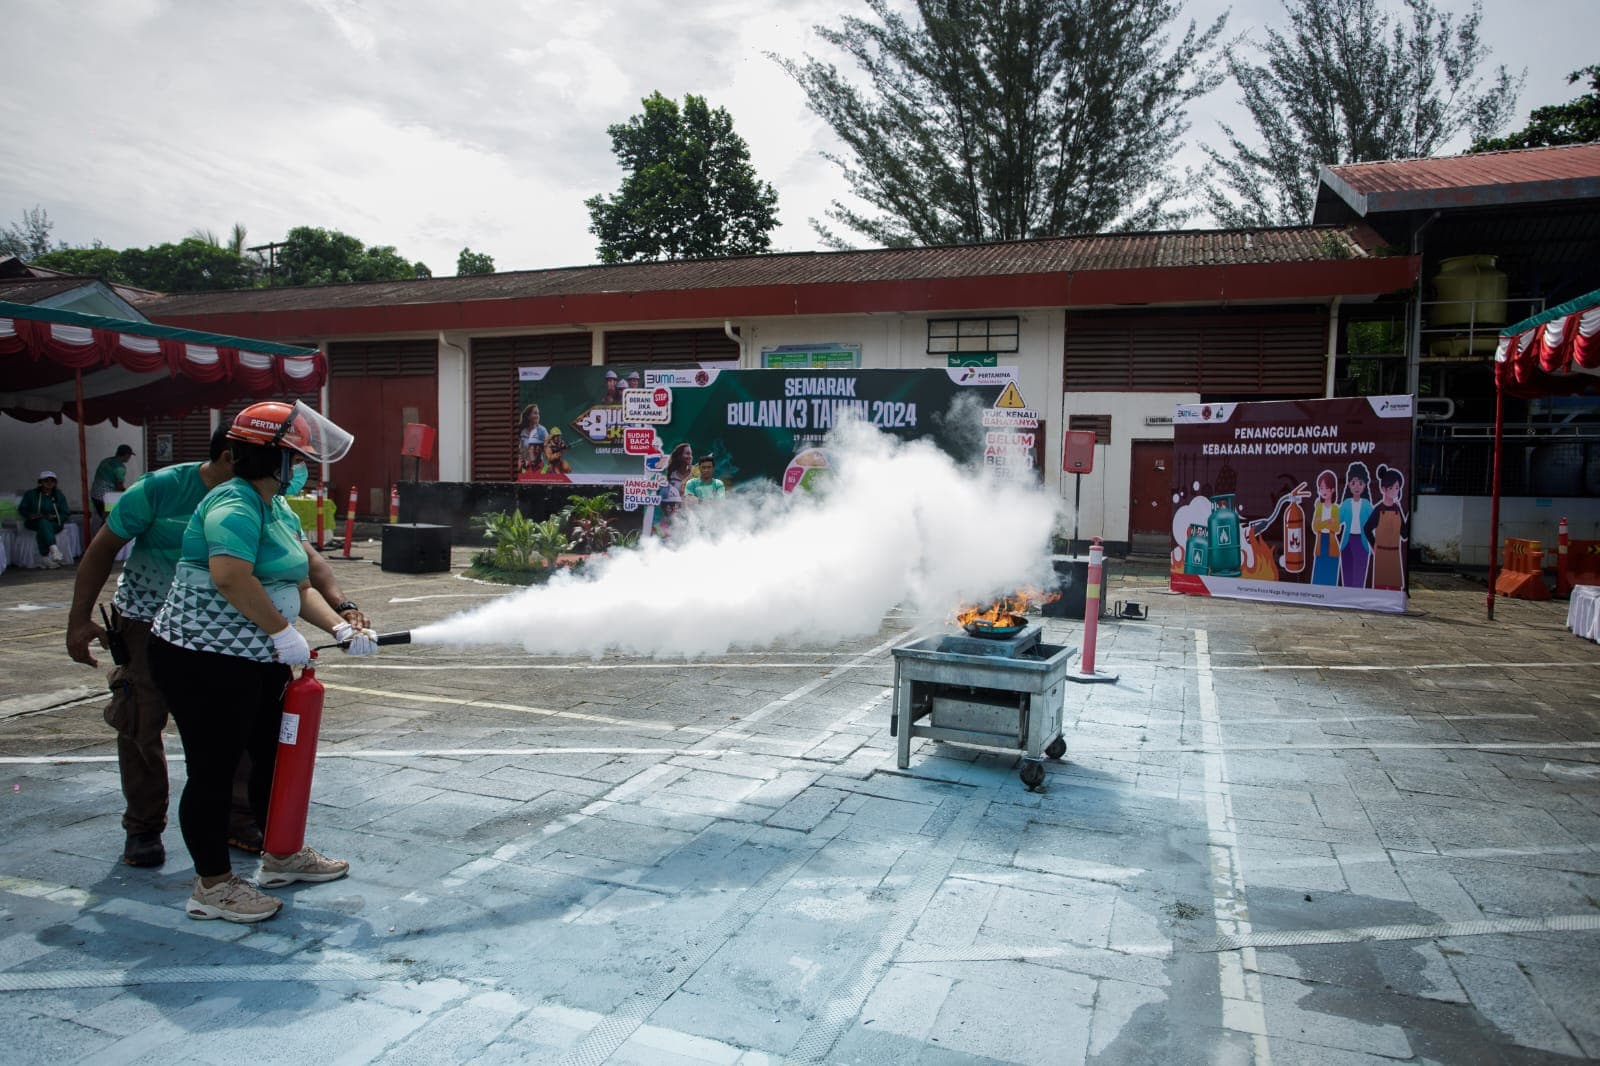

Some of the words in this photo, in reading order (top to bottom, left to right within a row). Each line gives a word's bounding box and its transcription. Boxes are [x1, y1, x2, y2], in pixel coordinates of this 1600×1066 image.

[784, 377, 857, 397] SEMARAK
[655, 393, 667, 401] STOP
[727, 400, 782, 428] BULAN
[785, 399, 808, 429] K3
[872, 400, 918, 429] 2024
[1006, 410, 1037, 419] KENALI
[250, 418, 296, 433] PERTAMA
[1235, 425, 1338, 439] PENANGGULANGAN
[987, 433, 1033, 446] BELUM
[1202, 443, 1262, 455] KEBAKARAN
[1265, 442, 1309, 455] KOMPOR
[1311, 442, 1348, 455] UNTUK
[1350, 441, 1376, 454] PWP
[624, 480, 658, 489] JANGAN
[625, 487, 647, 495] LUPA
[624, 495, 660, 504] FOLLOW
